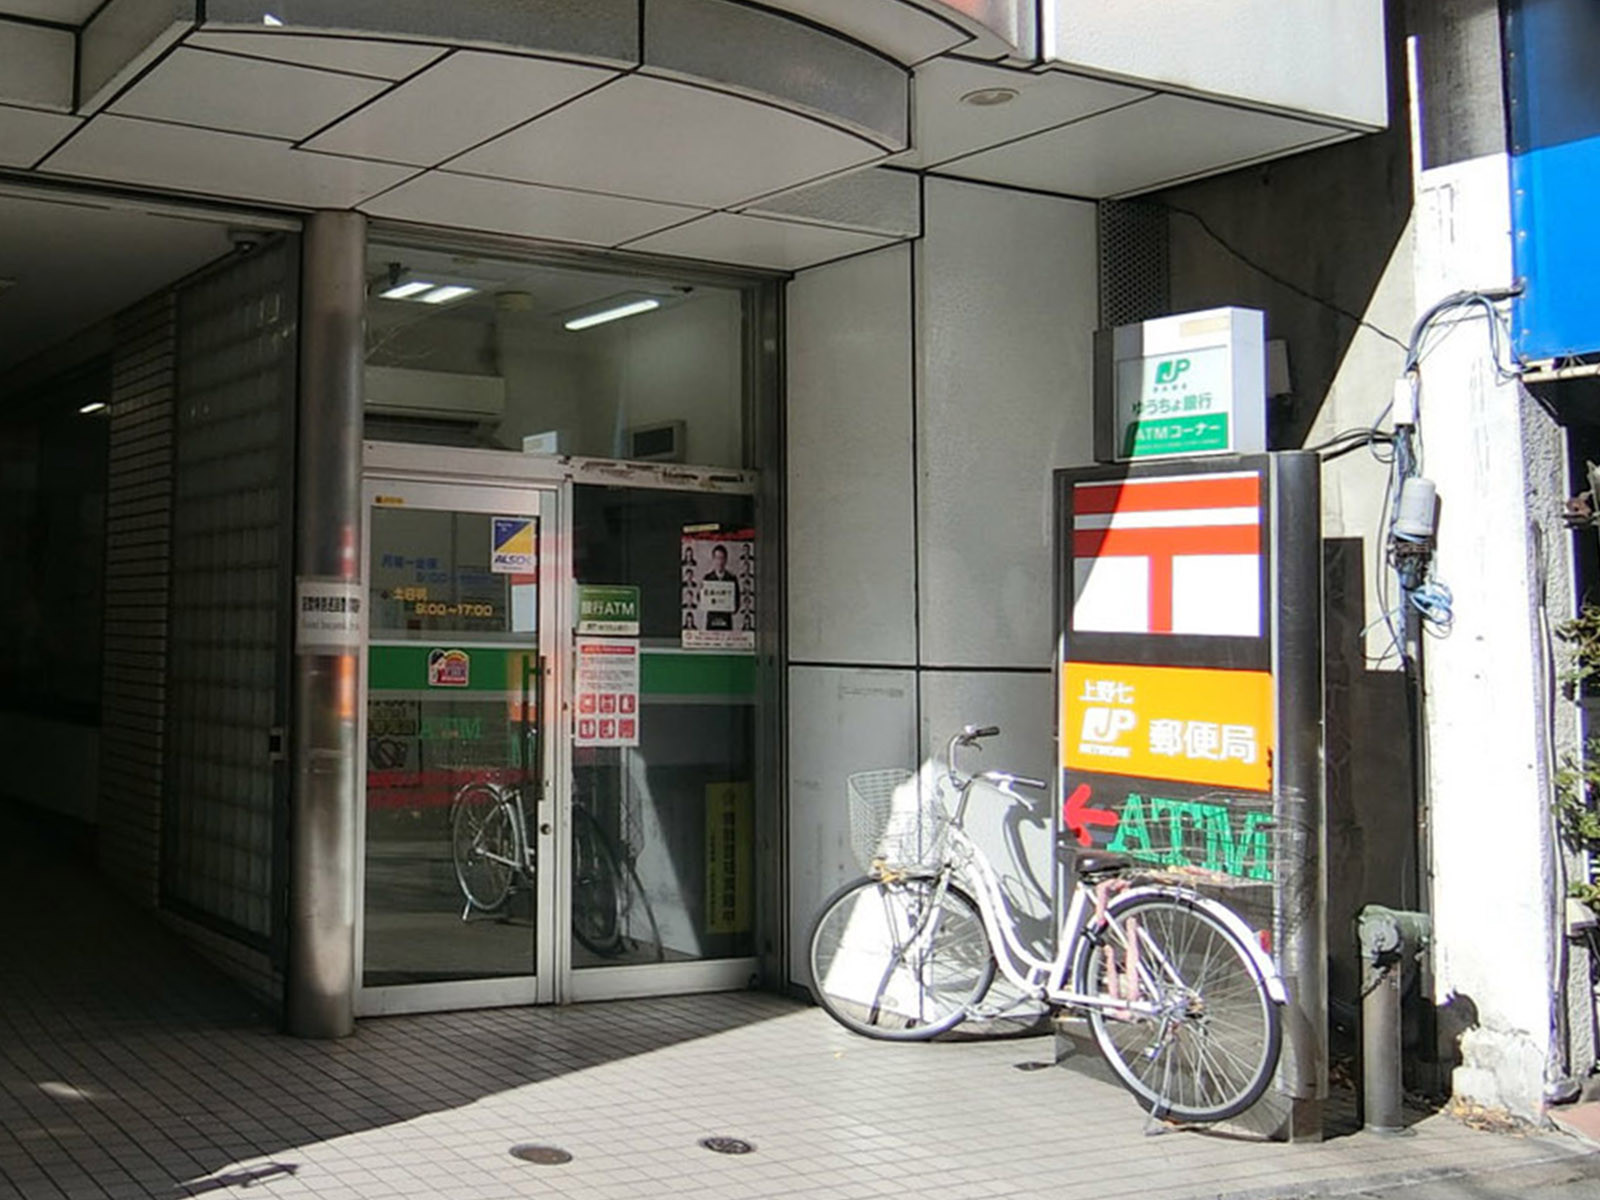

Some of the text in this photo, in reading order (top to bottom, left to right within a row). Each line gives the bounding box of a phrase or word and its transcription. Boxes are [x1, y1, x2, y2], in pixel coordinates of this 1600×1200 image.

[1131, 392, 1213, 416] ゆうちょ銀行
[1134, 422, 1221, 442] ATMコーナー
[1078, 679, 1136, 705] 上野七
[1149, 718, 1257, 764] 郵便局
[1106, 792, 1275, 881] ATM
